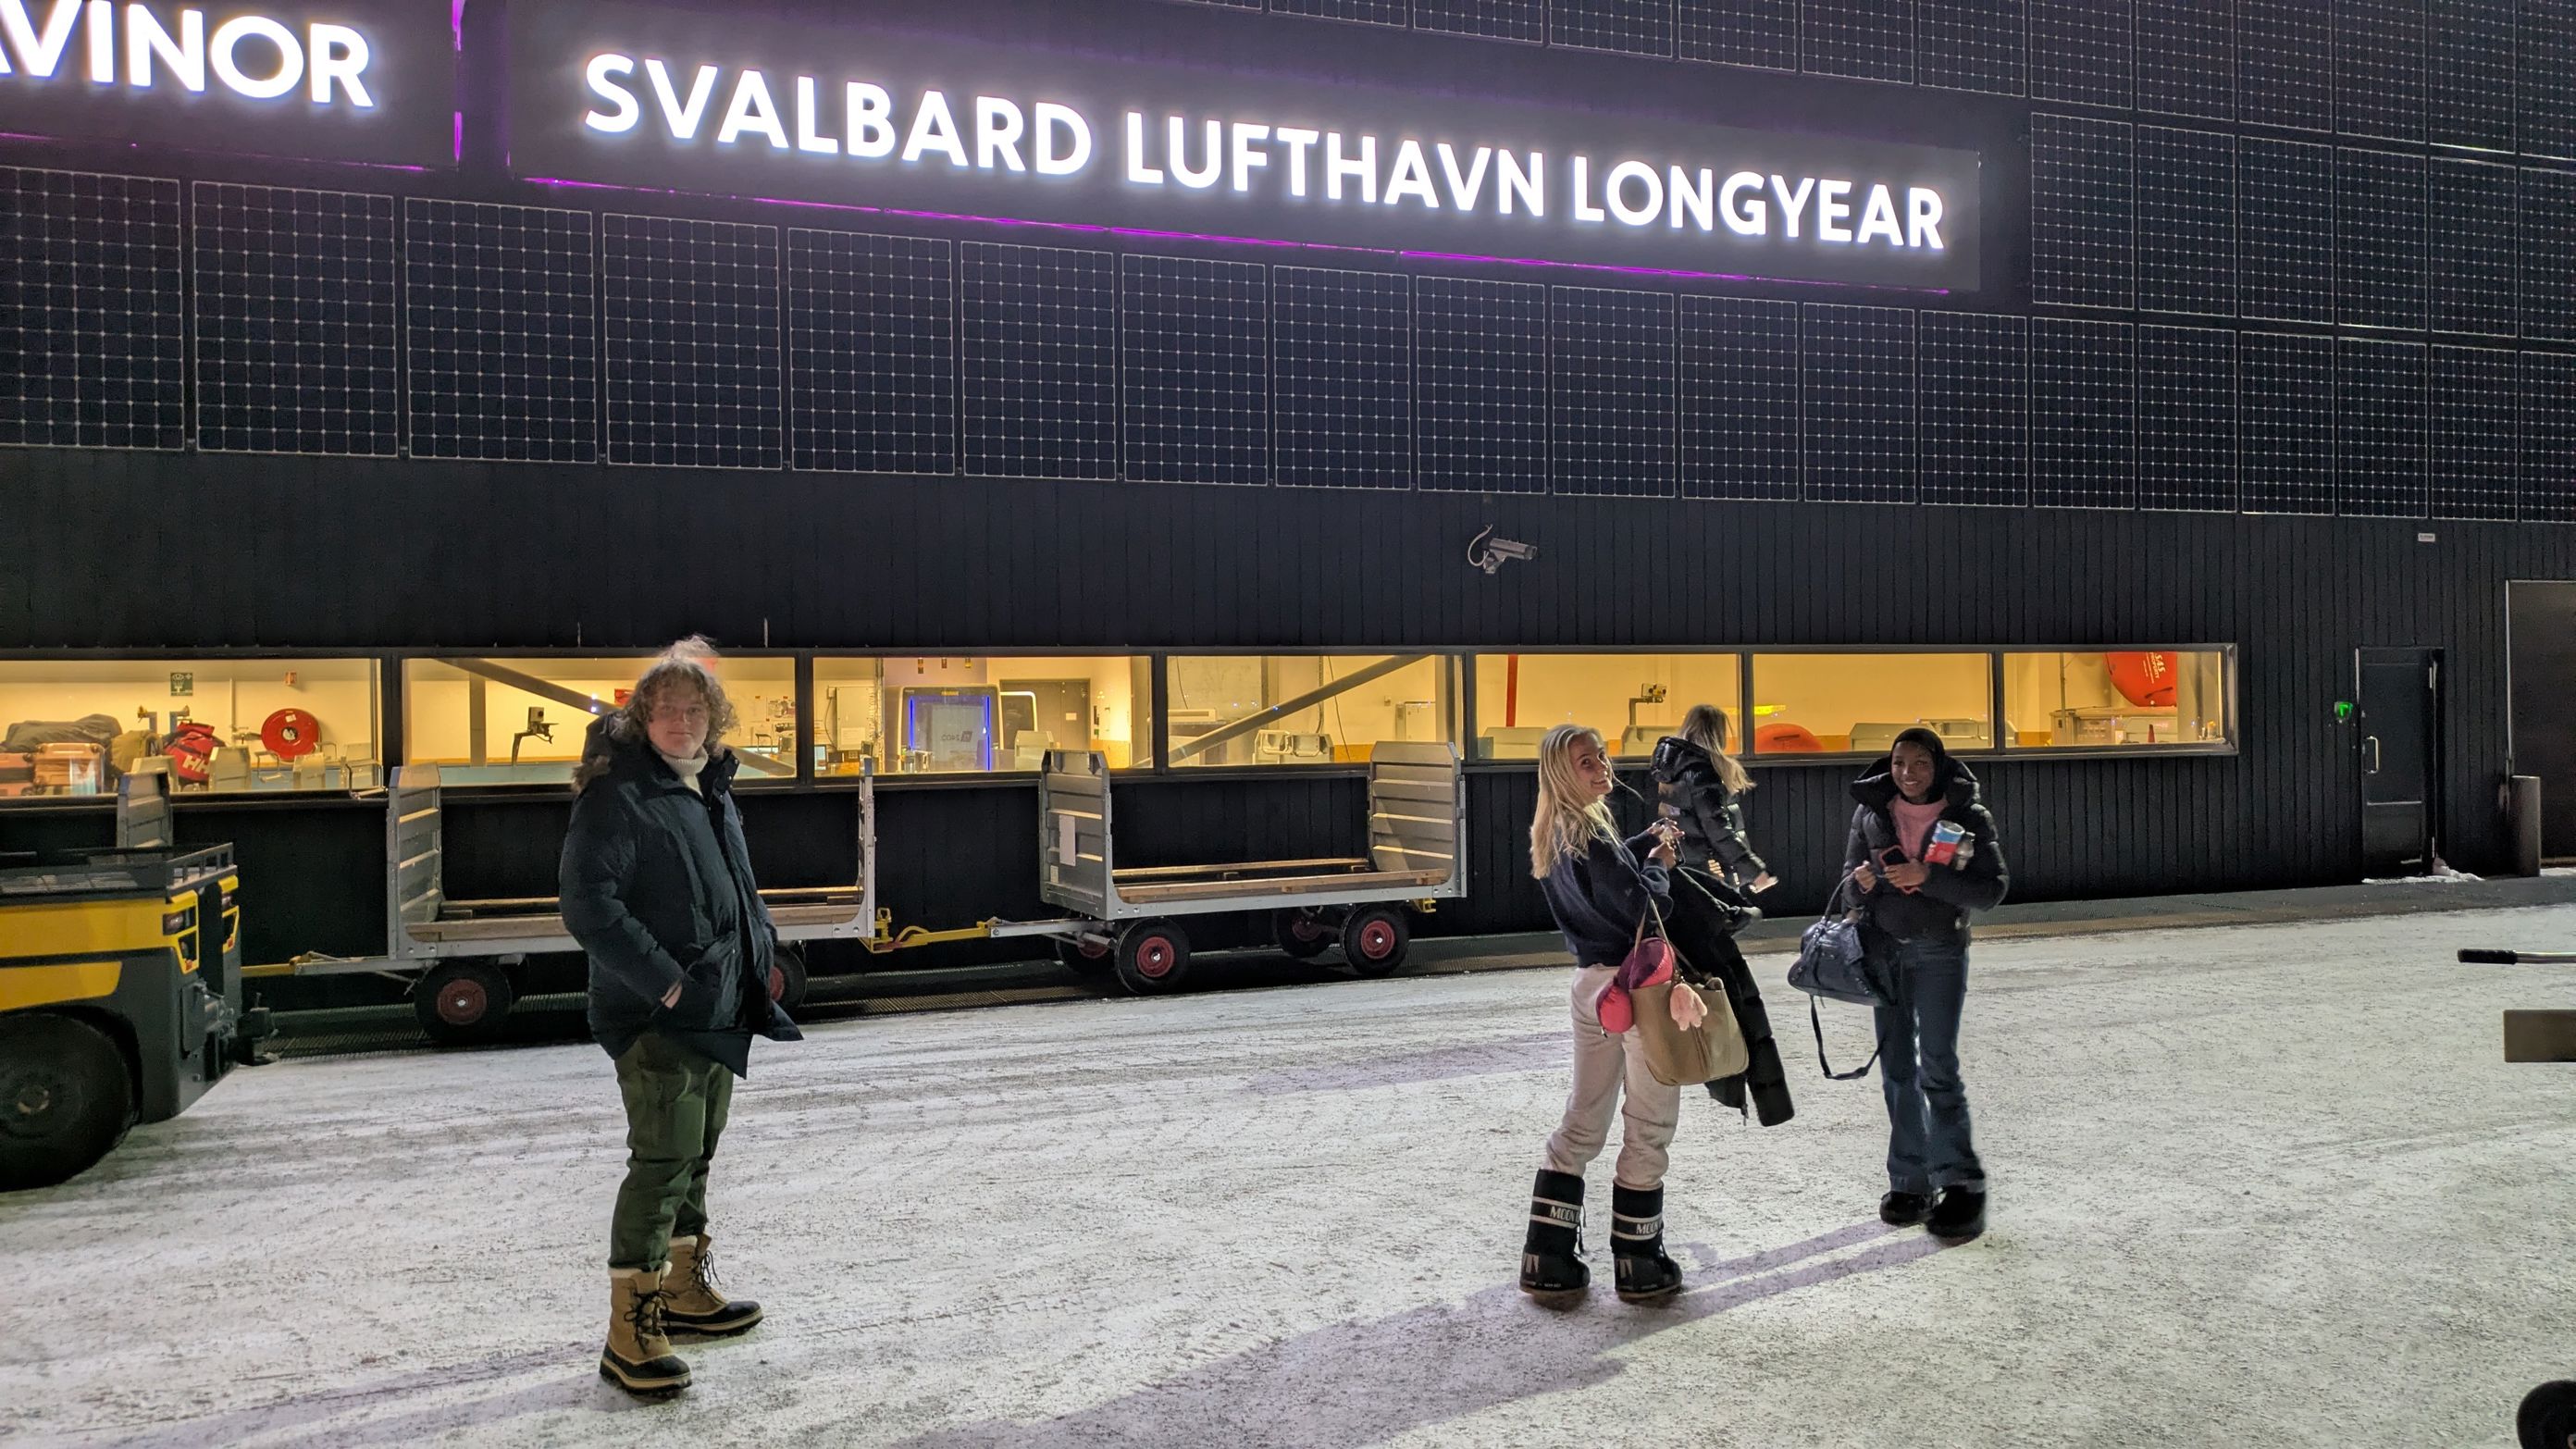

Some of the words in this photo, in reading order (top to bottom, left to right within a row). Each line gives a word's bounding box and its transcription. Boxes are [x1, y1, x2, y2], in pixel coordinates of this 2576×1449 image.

[0, 0, 374, 107] VINOR
[585, 54, 1093, 175] SVALBARD
[1126, 112, 1546, 221] LUFTHAVN
[1573, 155, 1945, 249] LONGYEAR
[2155, 653, 2166, 673] SAS
[1549, 1206, 1575, 1222] MOON
